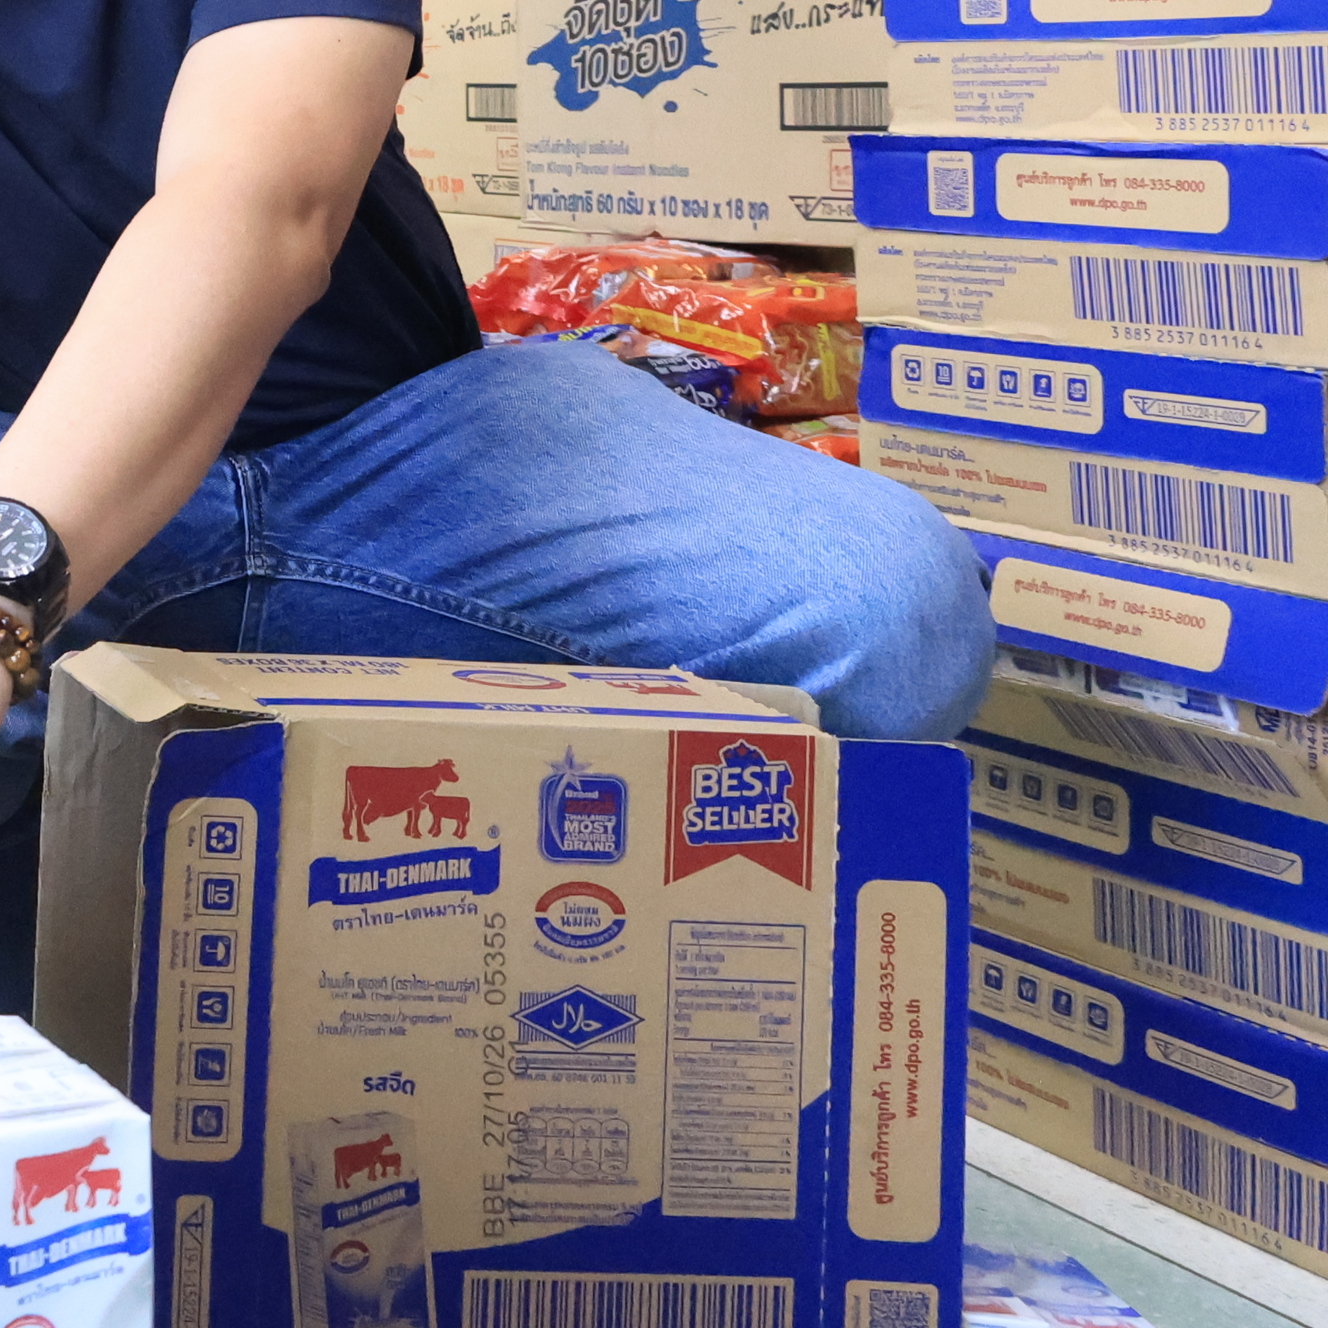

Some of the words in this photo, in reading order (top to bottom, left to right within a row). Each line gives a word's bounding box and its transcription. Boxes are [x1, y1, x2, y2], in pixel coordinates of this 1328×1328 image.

[572, 29, 685, 92] 10ซอง
[1123, 175, 1206, 193] 084-335-8000
[596, 192, 614, 215] 60
[617, 190, 644, 217] กรัม
[660, 195, 678, 218] 10
[724, 198, 745, 221] 18
[1069, 196, 1148, 212] www.dpo.go.th
[1122, 600, 1207, 630] 084-335-8000
[694, 765, 786, 799] BEST
[564, 821, 616, 835] MOST
[685, 802, 793, 833] SELLER
[563, 840, 616, 853] BRAND
[336, 857, 474, 894] THAI-DENMARK
[331, 895, 479, 932] ตราไทย-เดนมาร์ค
[482, 911, 507, 1007] 05355
[878, 911, 896, 1032] 084-335-8000
[551, 1001, 604, 1034] حلال
[874, 1043, 892, 1072] โทร
[906, 997, 923, 1119] www.dpo.go.th
[362, 1070, 416, 1097] รสจืด
[482, 1025, 506, 1148] 27/10/26
[871, 1080, 897, 1206] ศูนย์บริการลูกค้า
[483, 1173, 506, 1238] BBE
